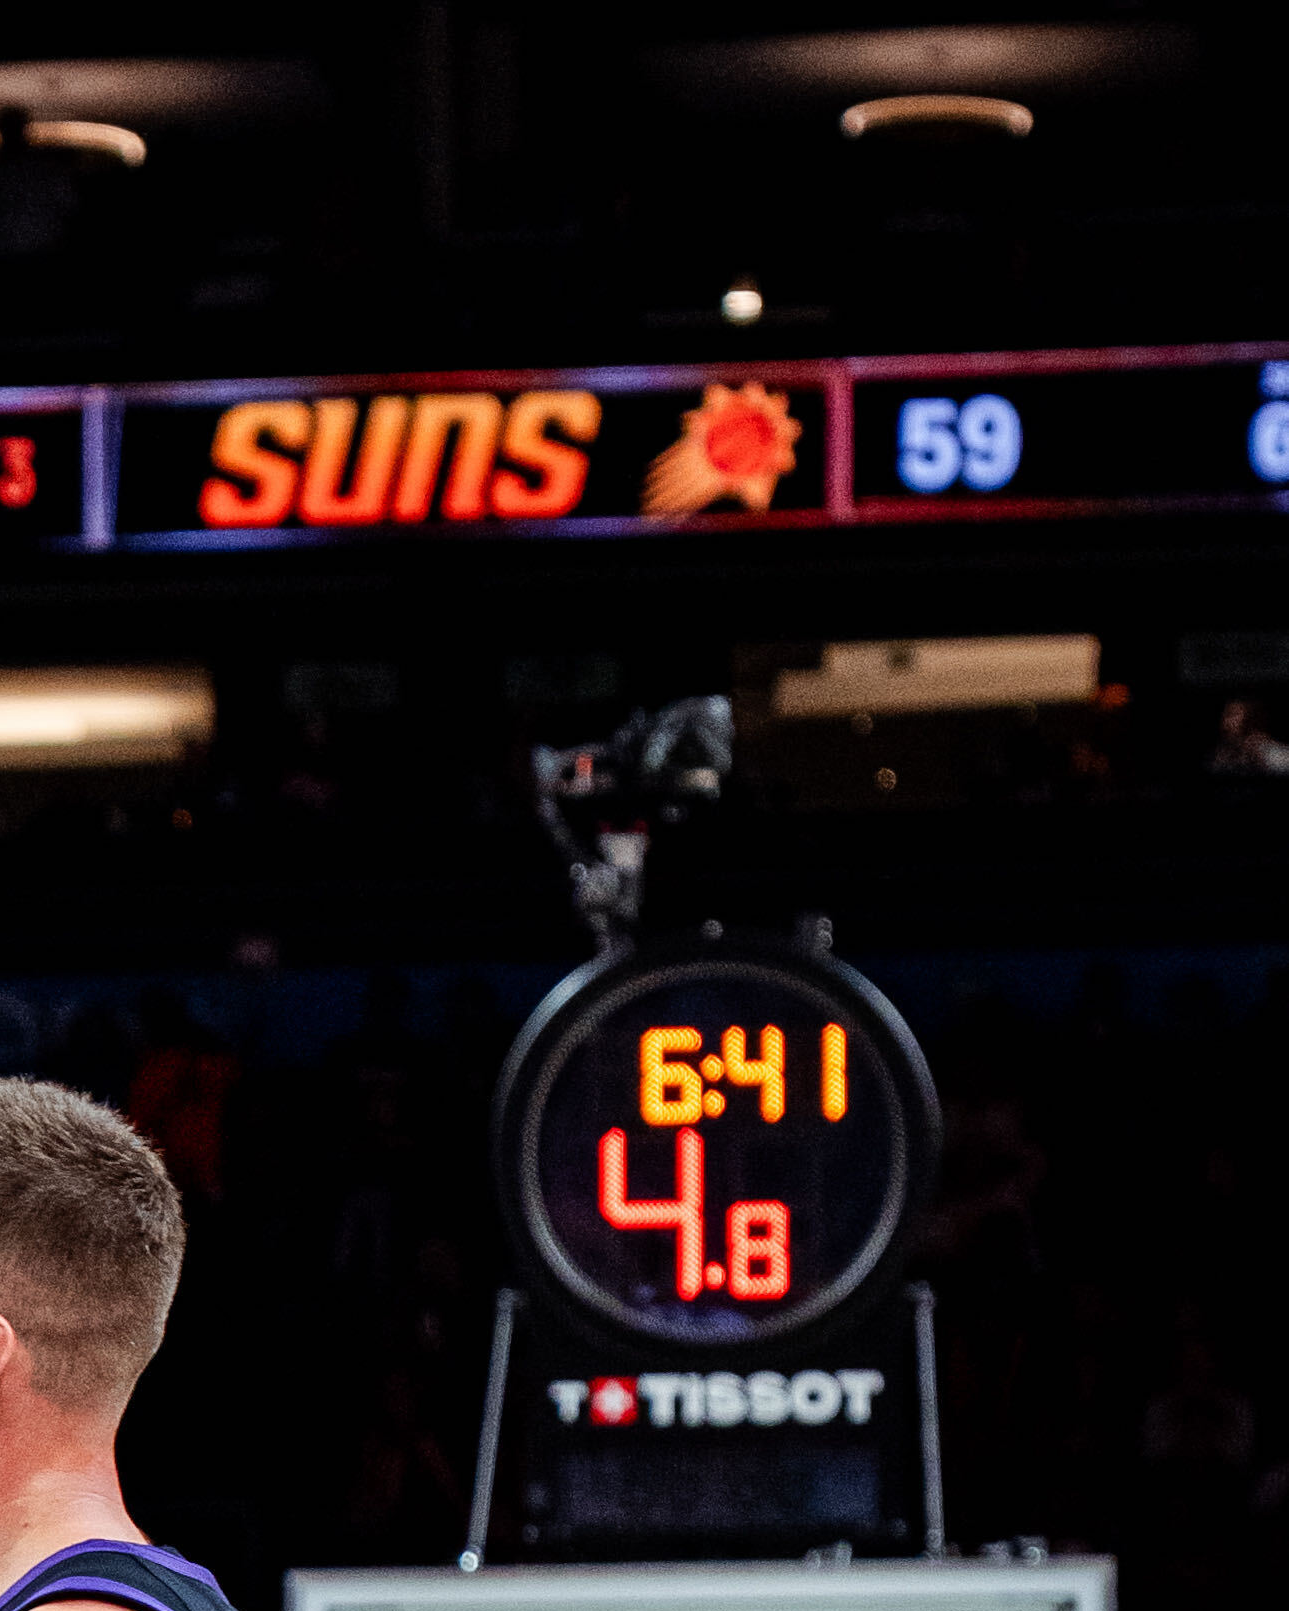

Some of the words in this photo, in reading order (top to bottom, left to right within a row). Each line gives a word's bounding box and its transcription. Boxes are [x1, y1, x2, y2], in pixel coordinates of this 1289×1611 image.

[198, 391, 602, 528] SUNS
[896, 396, 1022, 494] 59
[639, 1023, 847, 1125] 6:41
[598, 1128, 790, 1300] 4.8
[636, 1369, 884, 1426] TISSOT
